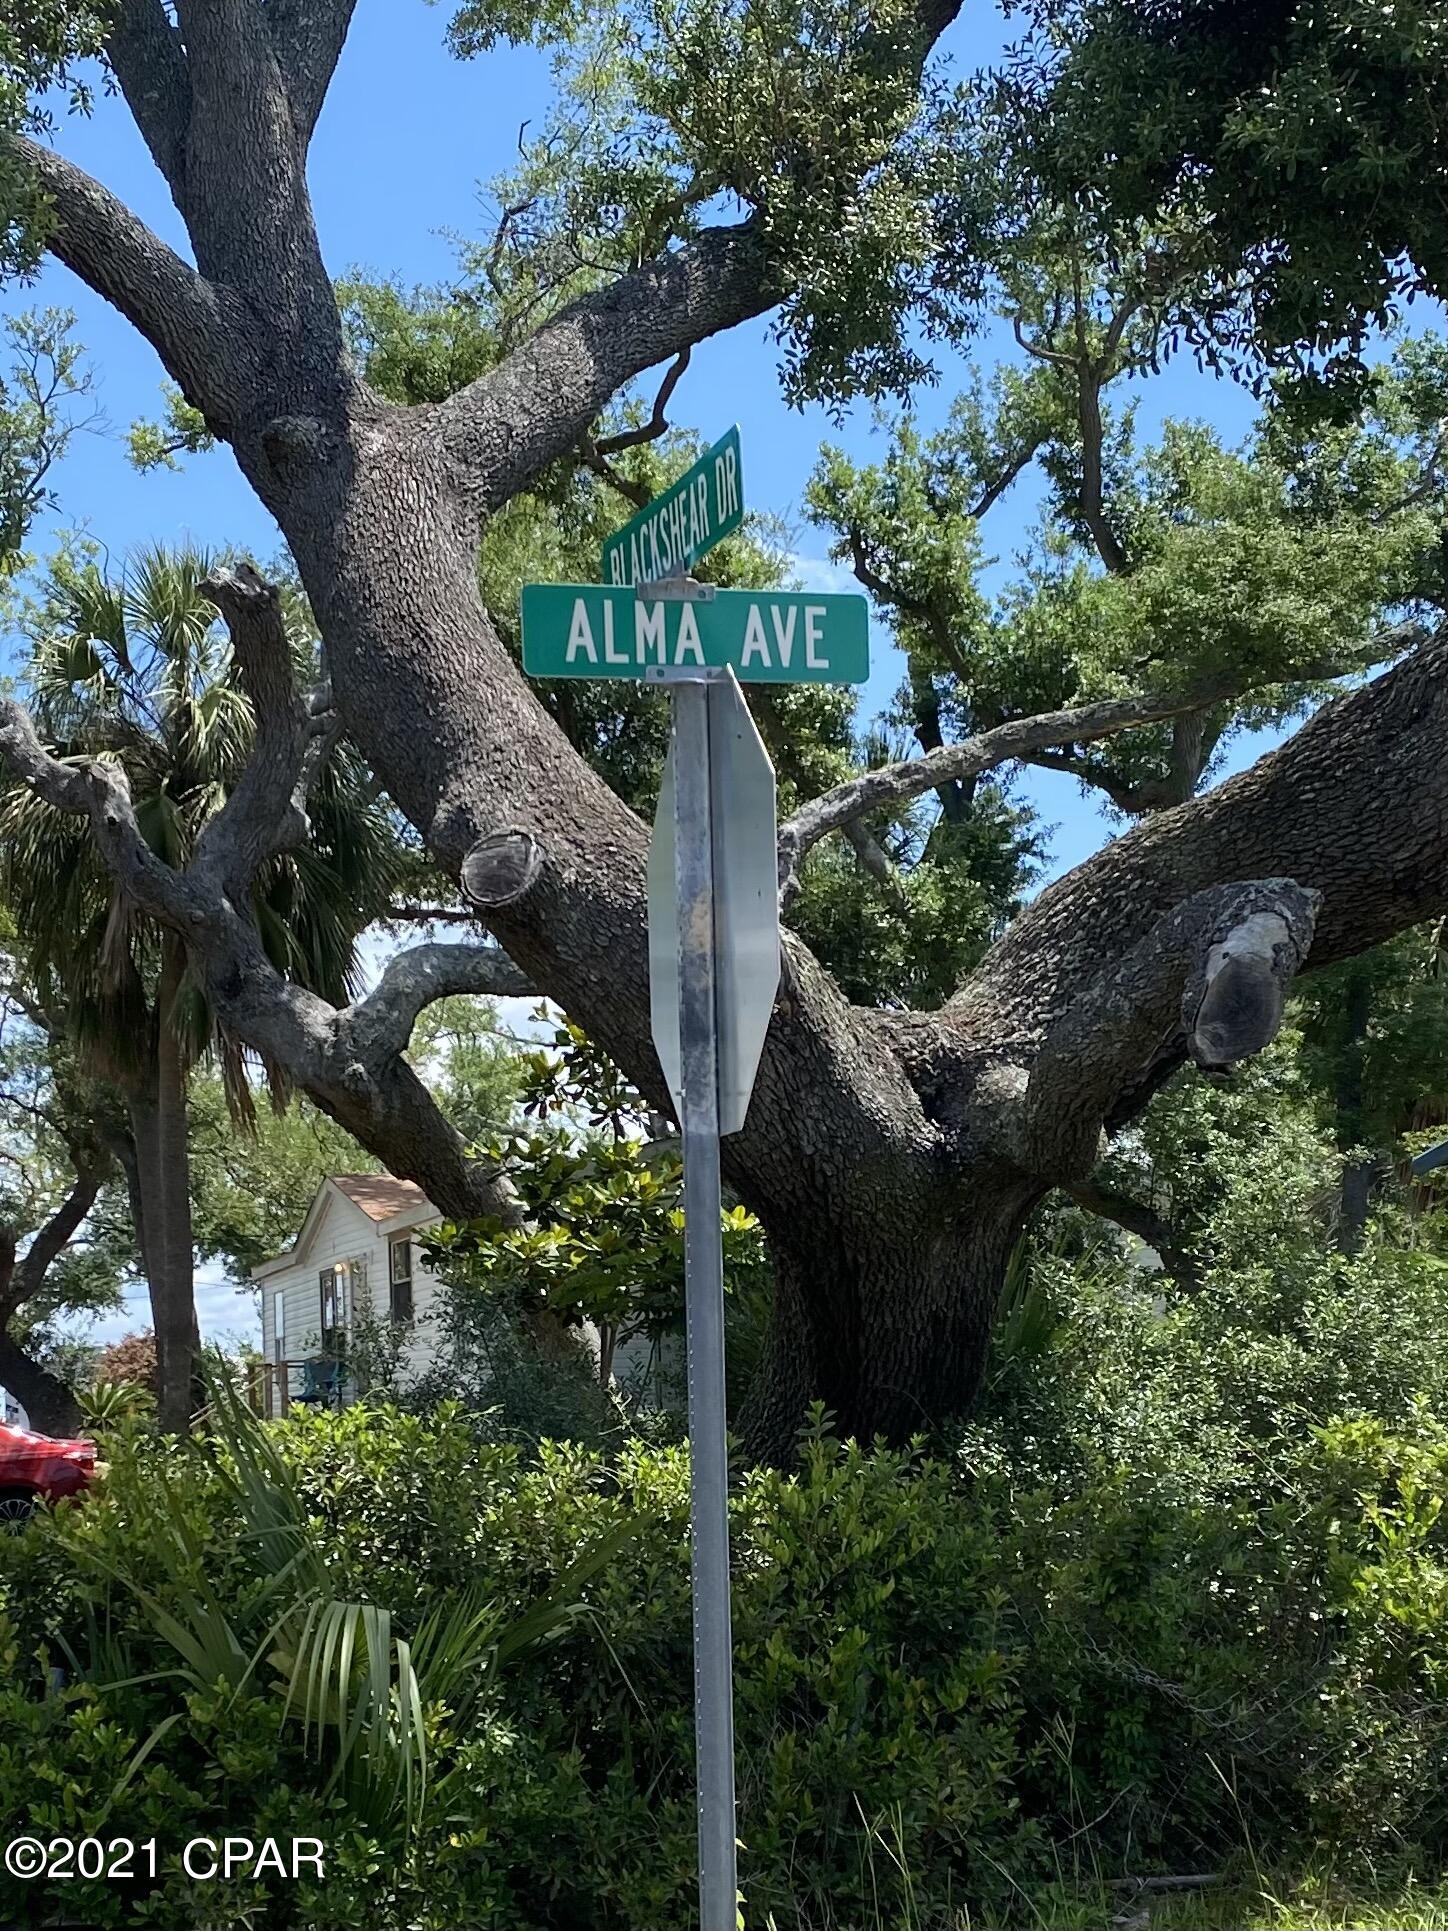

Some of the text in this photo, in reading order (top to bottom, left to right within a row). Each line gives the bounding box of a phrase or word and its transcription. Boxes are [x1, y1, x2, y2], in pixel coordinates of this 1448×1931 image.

[610, 446, 739, 586] BLACKSHEAR DR
[565, 598, 830, 669] ALMA AVE
